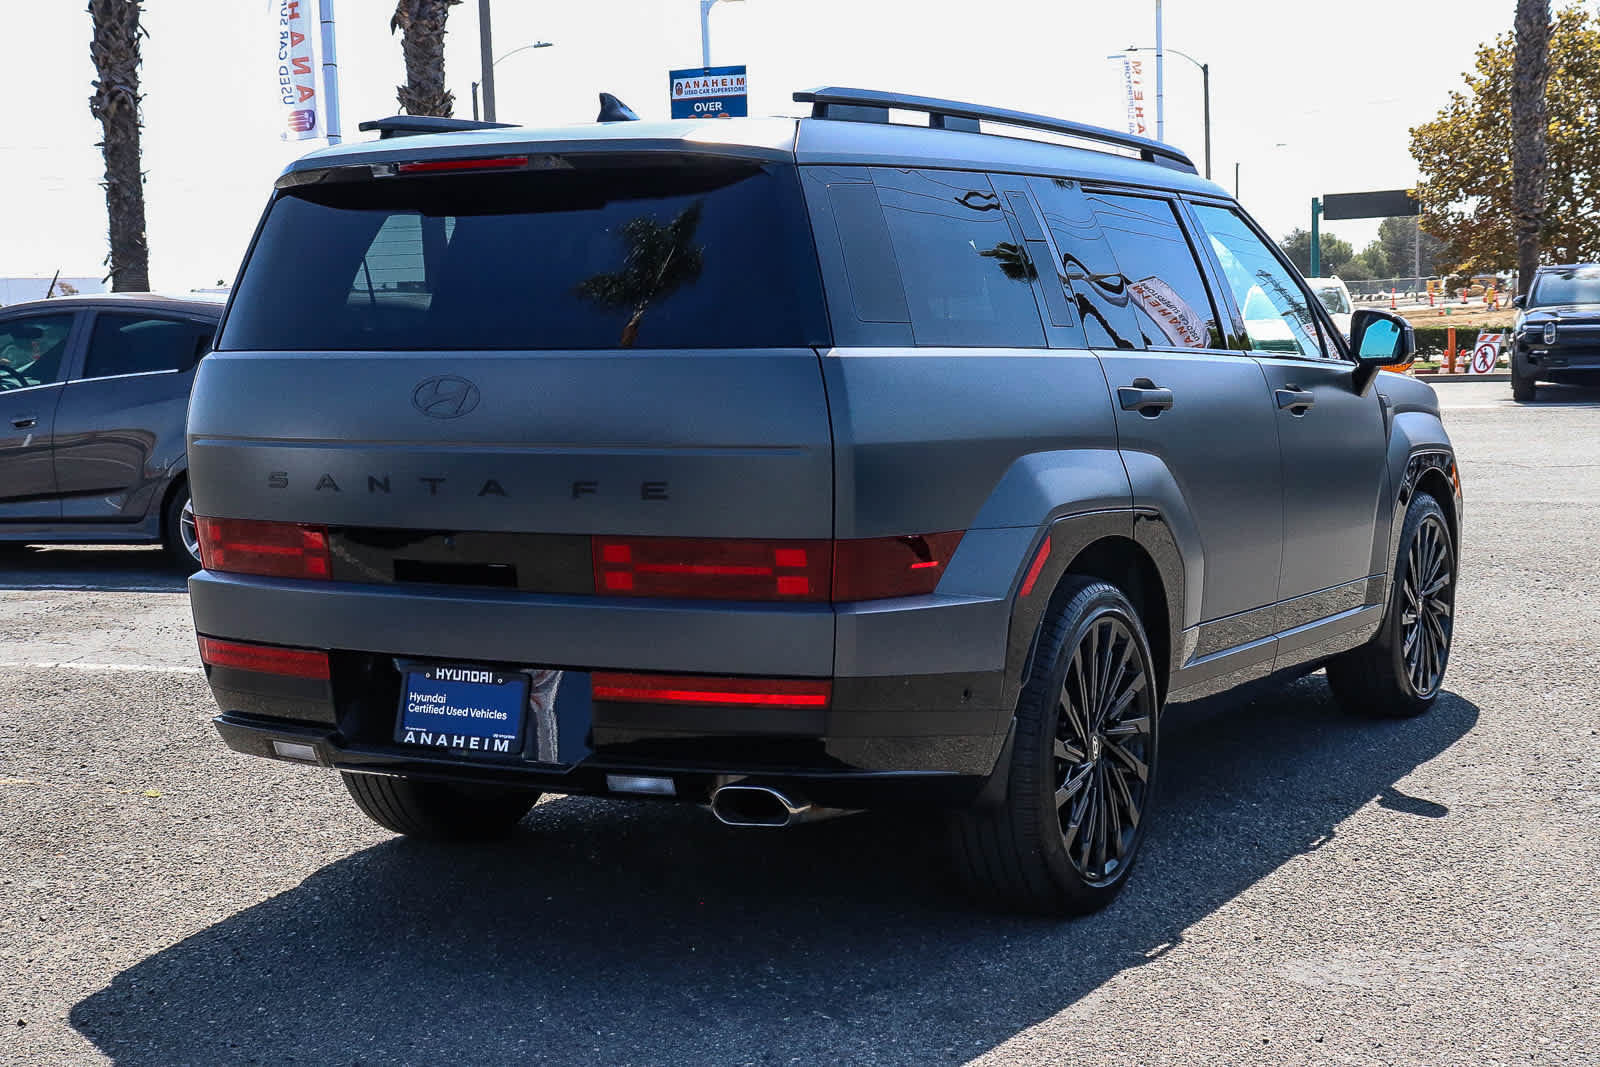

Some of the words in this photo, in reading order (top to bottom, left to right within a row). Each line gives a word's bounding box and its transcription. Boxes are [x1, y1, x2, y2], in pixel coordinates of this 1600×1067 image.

[685, 78, 745, 89] ANAHEIM
[710, 86, 745, 94] SUPERSTORE
[694, 101, 723, 112] OVER
[267, 471, 508, 498] SANTA
[572, 480, 670, 501] FE
[436, 667, 493, 683] HYUNDAI
[409, 691, 447, 704] Hyundai
[408, 703, 445, 715] Certified
[446, 706, 469, 717] Used
[470, 708, 507, 720] Vehicles
[403, 731, 510, 752] ANAHEIM
